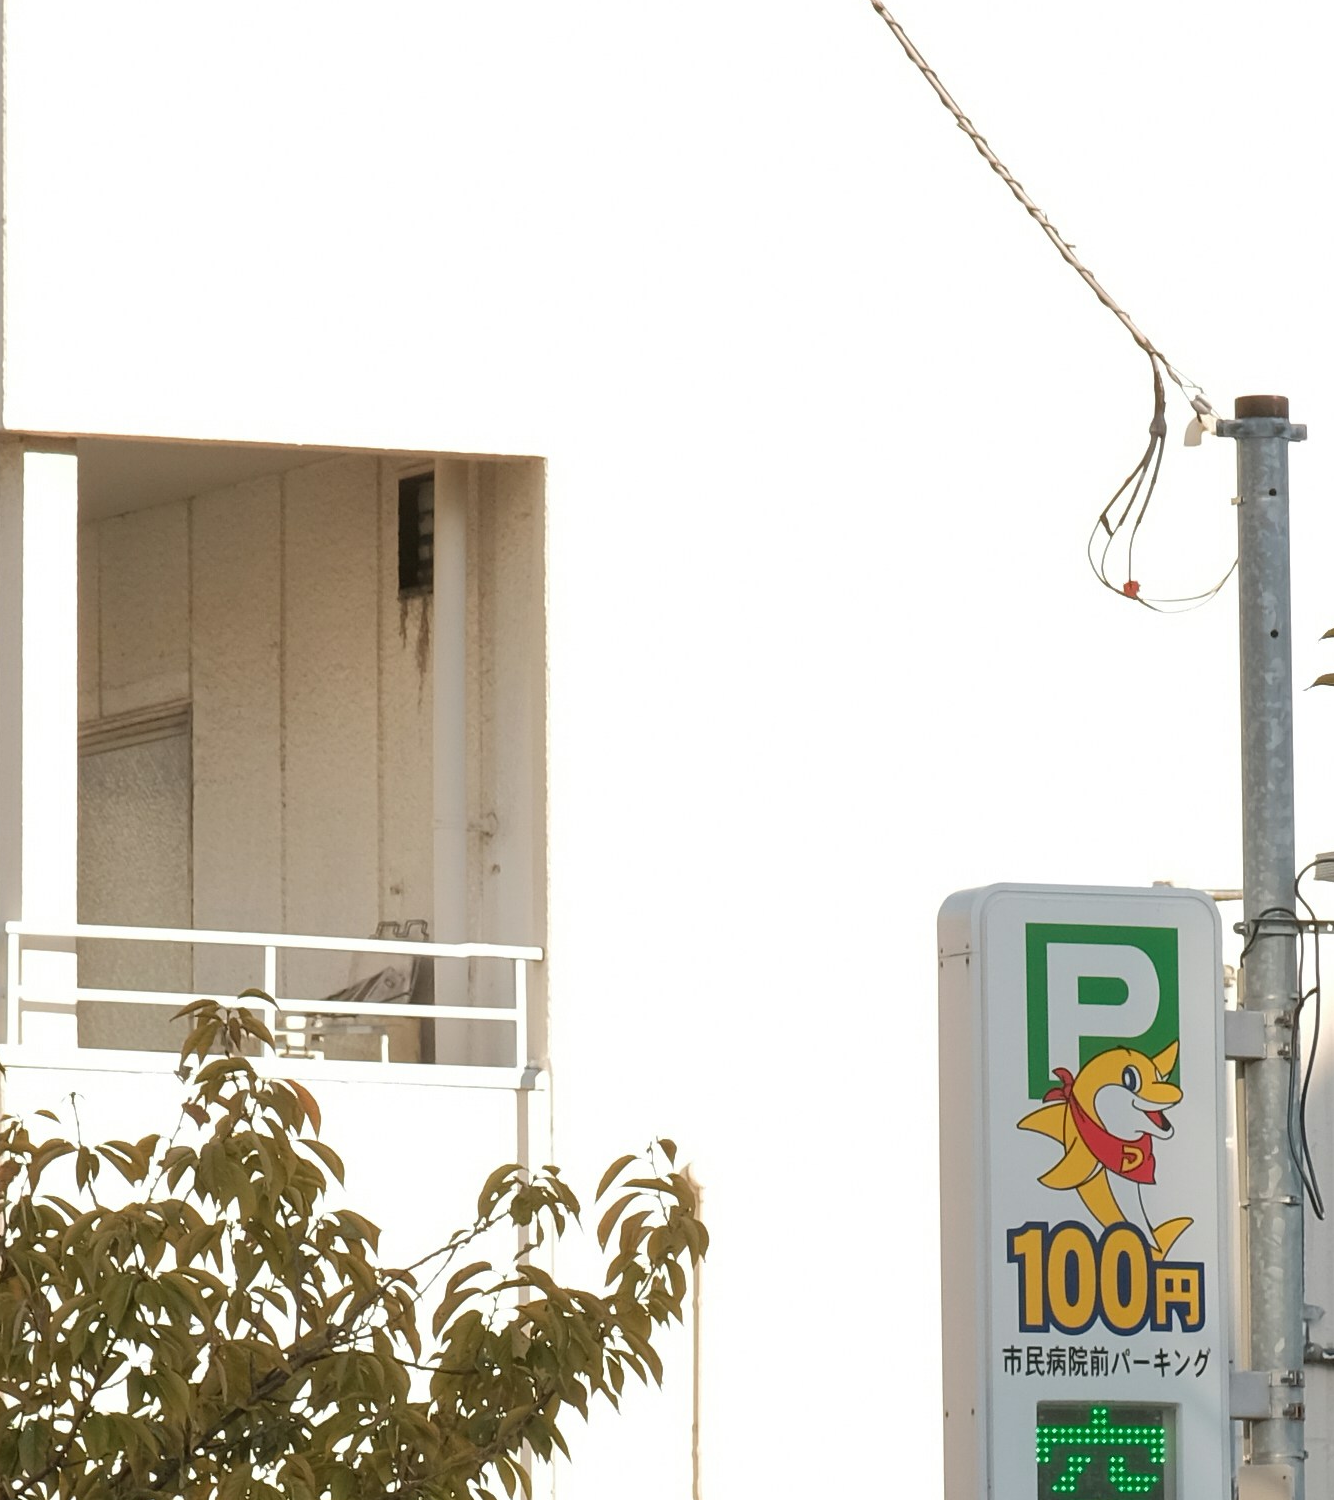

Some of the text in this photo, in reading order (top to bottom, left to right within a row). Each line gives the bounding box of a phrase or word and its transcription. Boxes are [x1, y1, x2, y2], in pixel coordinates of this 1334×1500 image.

[1047, 943, 1160, 1083] P
[1006, 1220, 1206, 1336] 100円
[1002, 1345, 1211, 1377] 市民病院前パーキング
